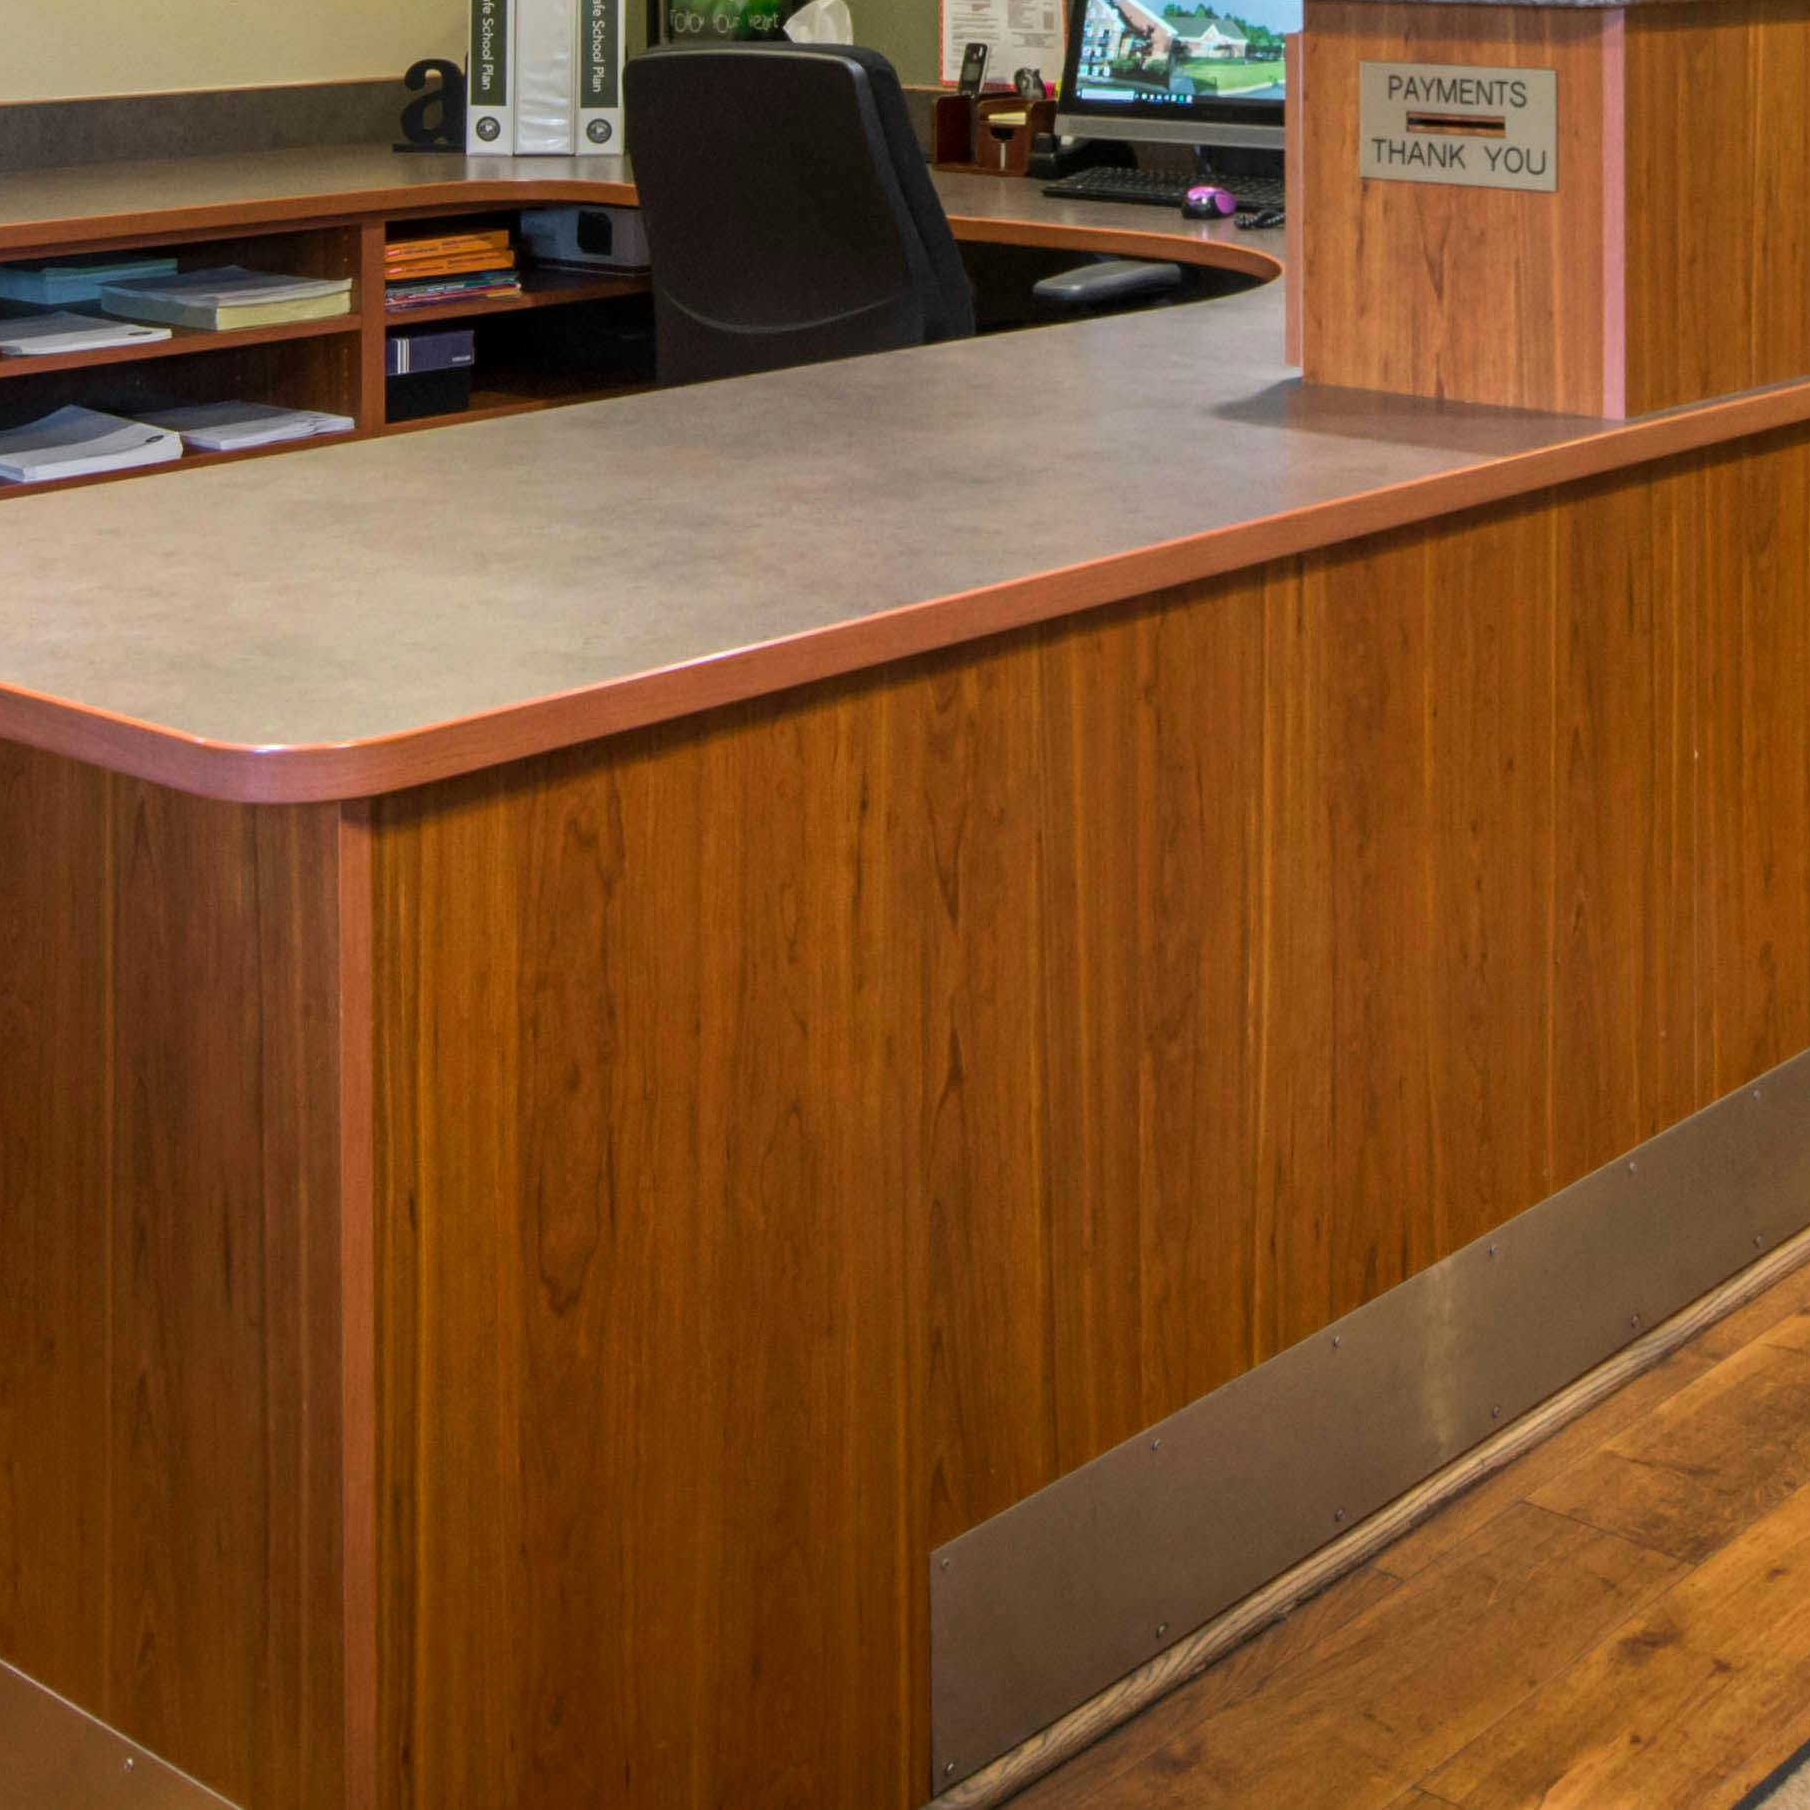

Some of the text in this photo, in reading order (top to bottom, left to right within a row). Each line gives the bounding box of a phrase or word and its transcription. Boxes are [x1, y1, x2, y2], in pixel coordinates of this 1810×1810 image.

[482, 18, 494, 60] School
[592, 21, 605, 62] School
[482, 64, 494, 90] Plan
[592, 66, 605, 92] Plan
[1387, 75, 1527, 108] PAYMENTS
[401, 58, 466, 144] a
[1372, 138, 1547, 175] THANK YOU
